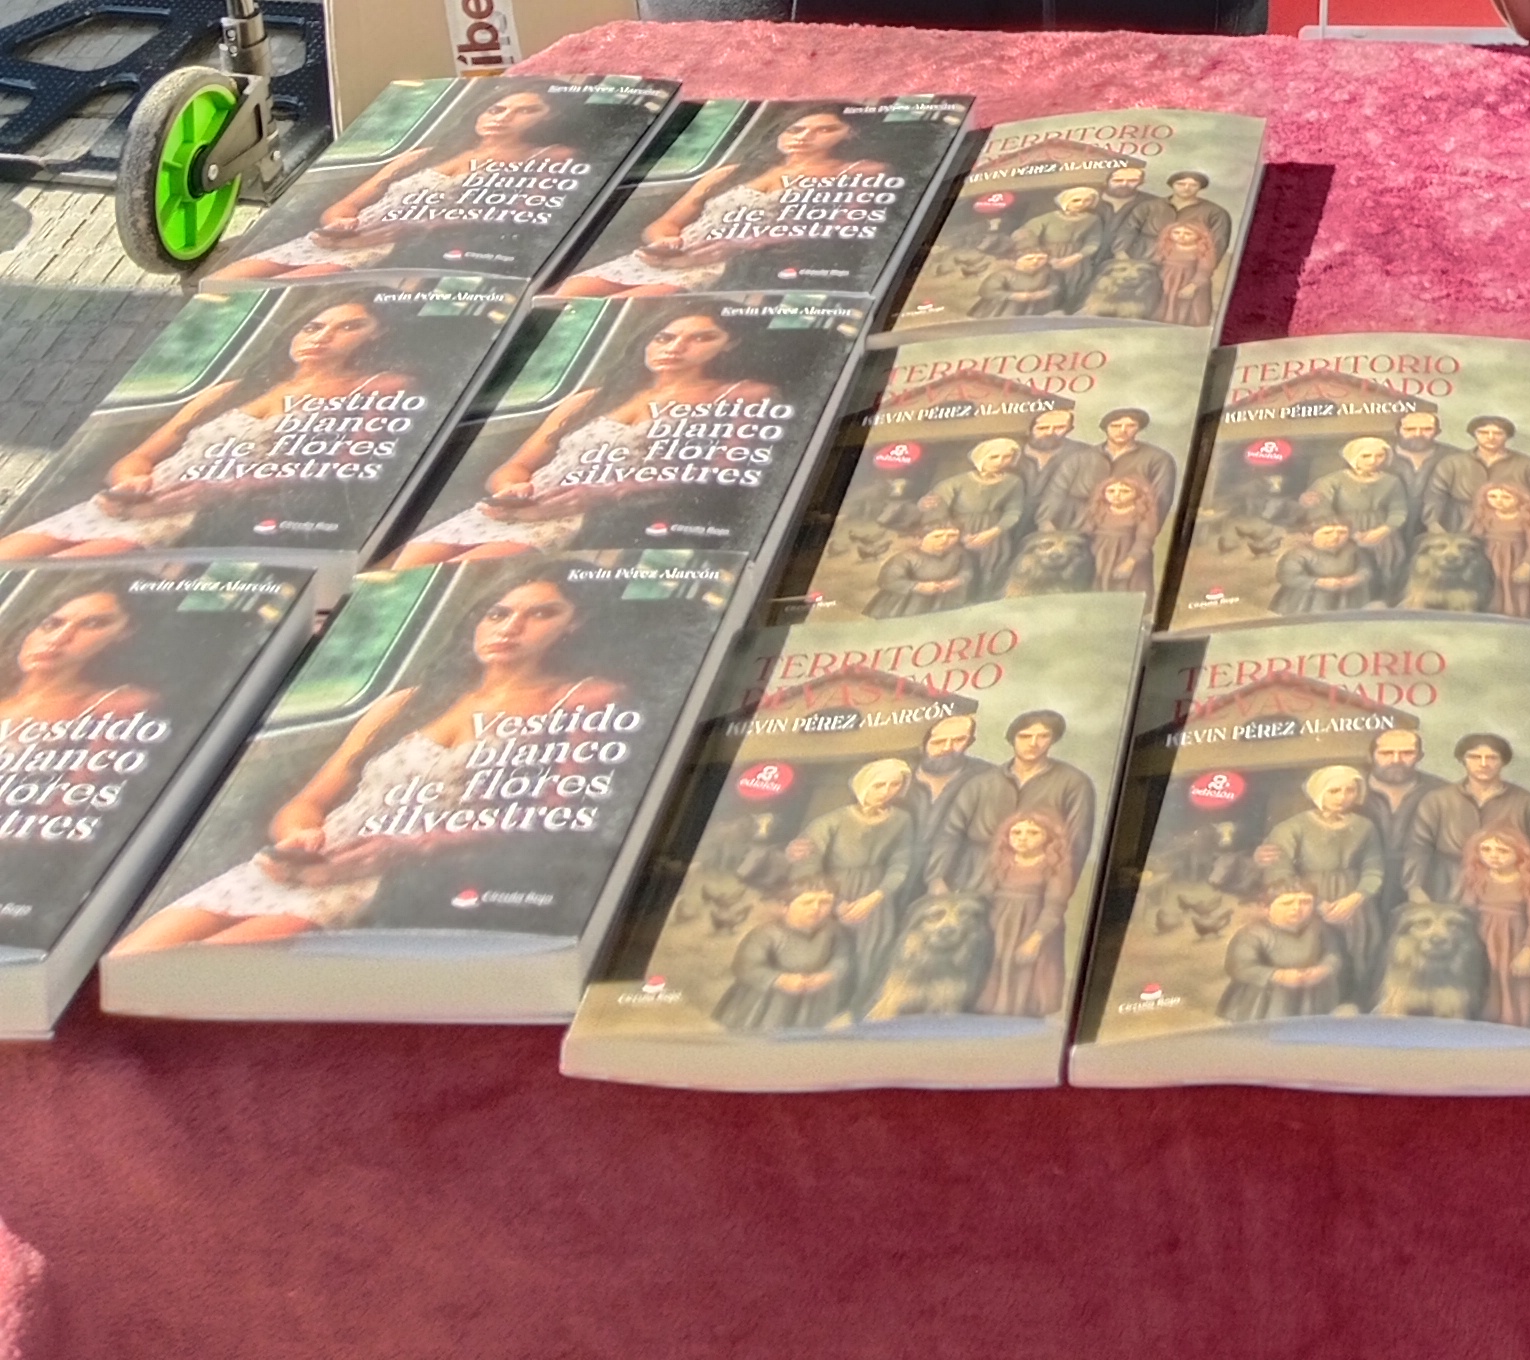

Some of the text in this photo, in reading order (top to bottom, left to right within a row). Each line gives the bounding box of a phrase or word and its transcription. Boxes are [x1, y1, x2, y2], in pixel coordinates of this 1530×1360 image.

[982, 123, 1174, 155] TERRITORIO
[468, 158, 591, 174] Vestido
[462, 173, 578, 191] blanco
[780, 173, 905, 189] Vestido
[402, 186, 565, 209] de flores
[779, 188, 897, 204] blanco
[382, 205, 553, 225] silvestres
[723, 203, 887, 224] de flores
[706, 222, 876, 240] silvestres
[885, 349, 1107, 385] TERRITORIO
[1236, 353, 1461, 385] TERRITORIO
[282, 390, 426, 412] Vestido
[647, 397, 794, 419] Vestido
[1225, 400, 1416, 424] KEVIN PÉREZ ALARCÓN
[275, 411, 413, 433] blanco
[647, 419, 783, 441] blanco
[203, 432, 397, 459] de flores
[580, 439, 773, 464] de flores
[180, 458, 383, 481] silvestres
[560, 462, 762, 486] silvestres
[754, 627, 1020, 680] TERRITORIO
[1178, 650, 1447, 693] TERRITORIO
[470, 703, 642, 737] Vestido
[792, 713, 857, 733] PÉREZ
[859, 701, 954, 728] ALARCÓN
[1165, 712, 1394, 747] KEVIN PÉREZ ALARCÓN
[466, 738, 629, 770] blanco
[384, 768, 612, 807] de flores
[358, 805, 600, 836] silvestres
